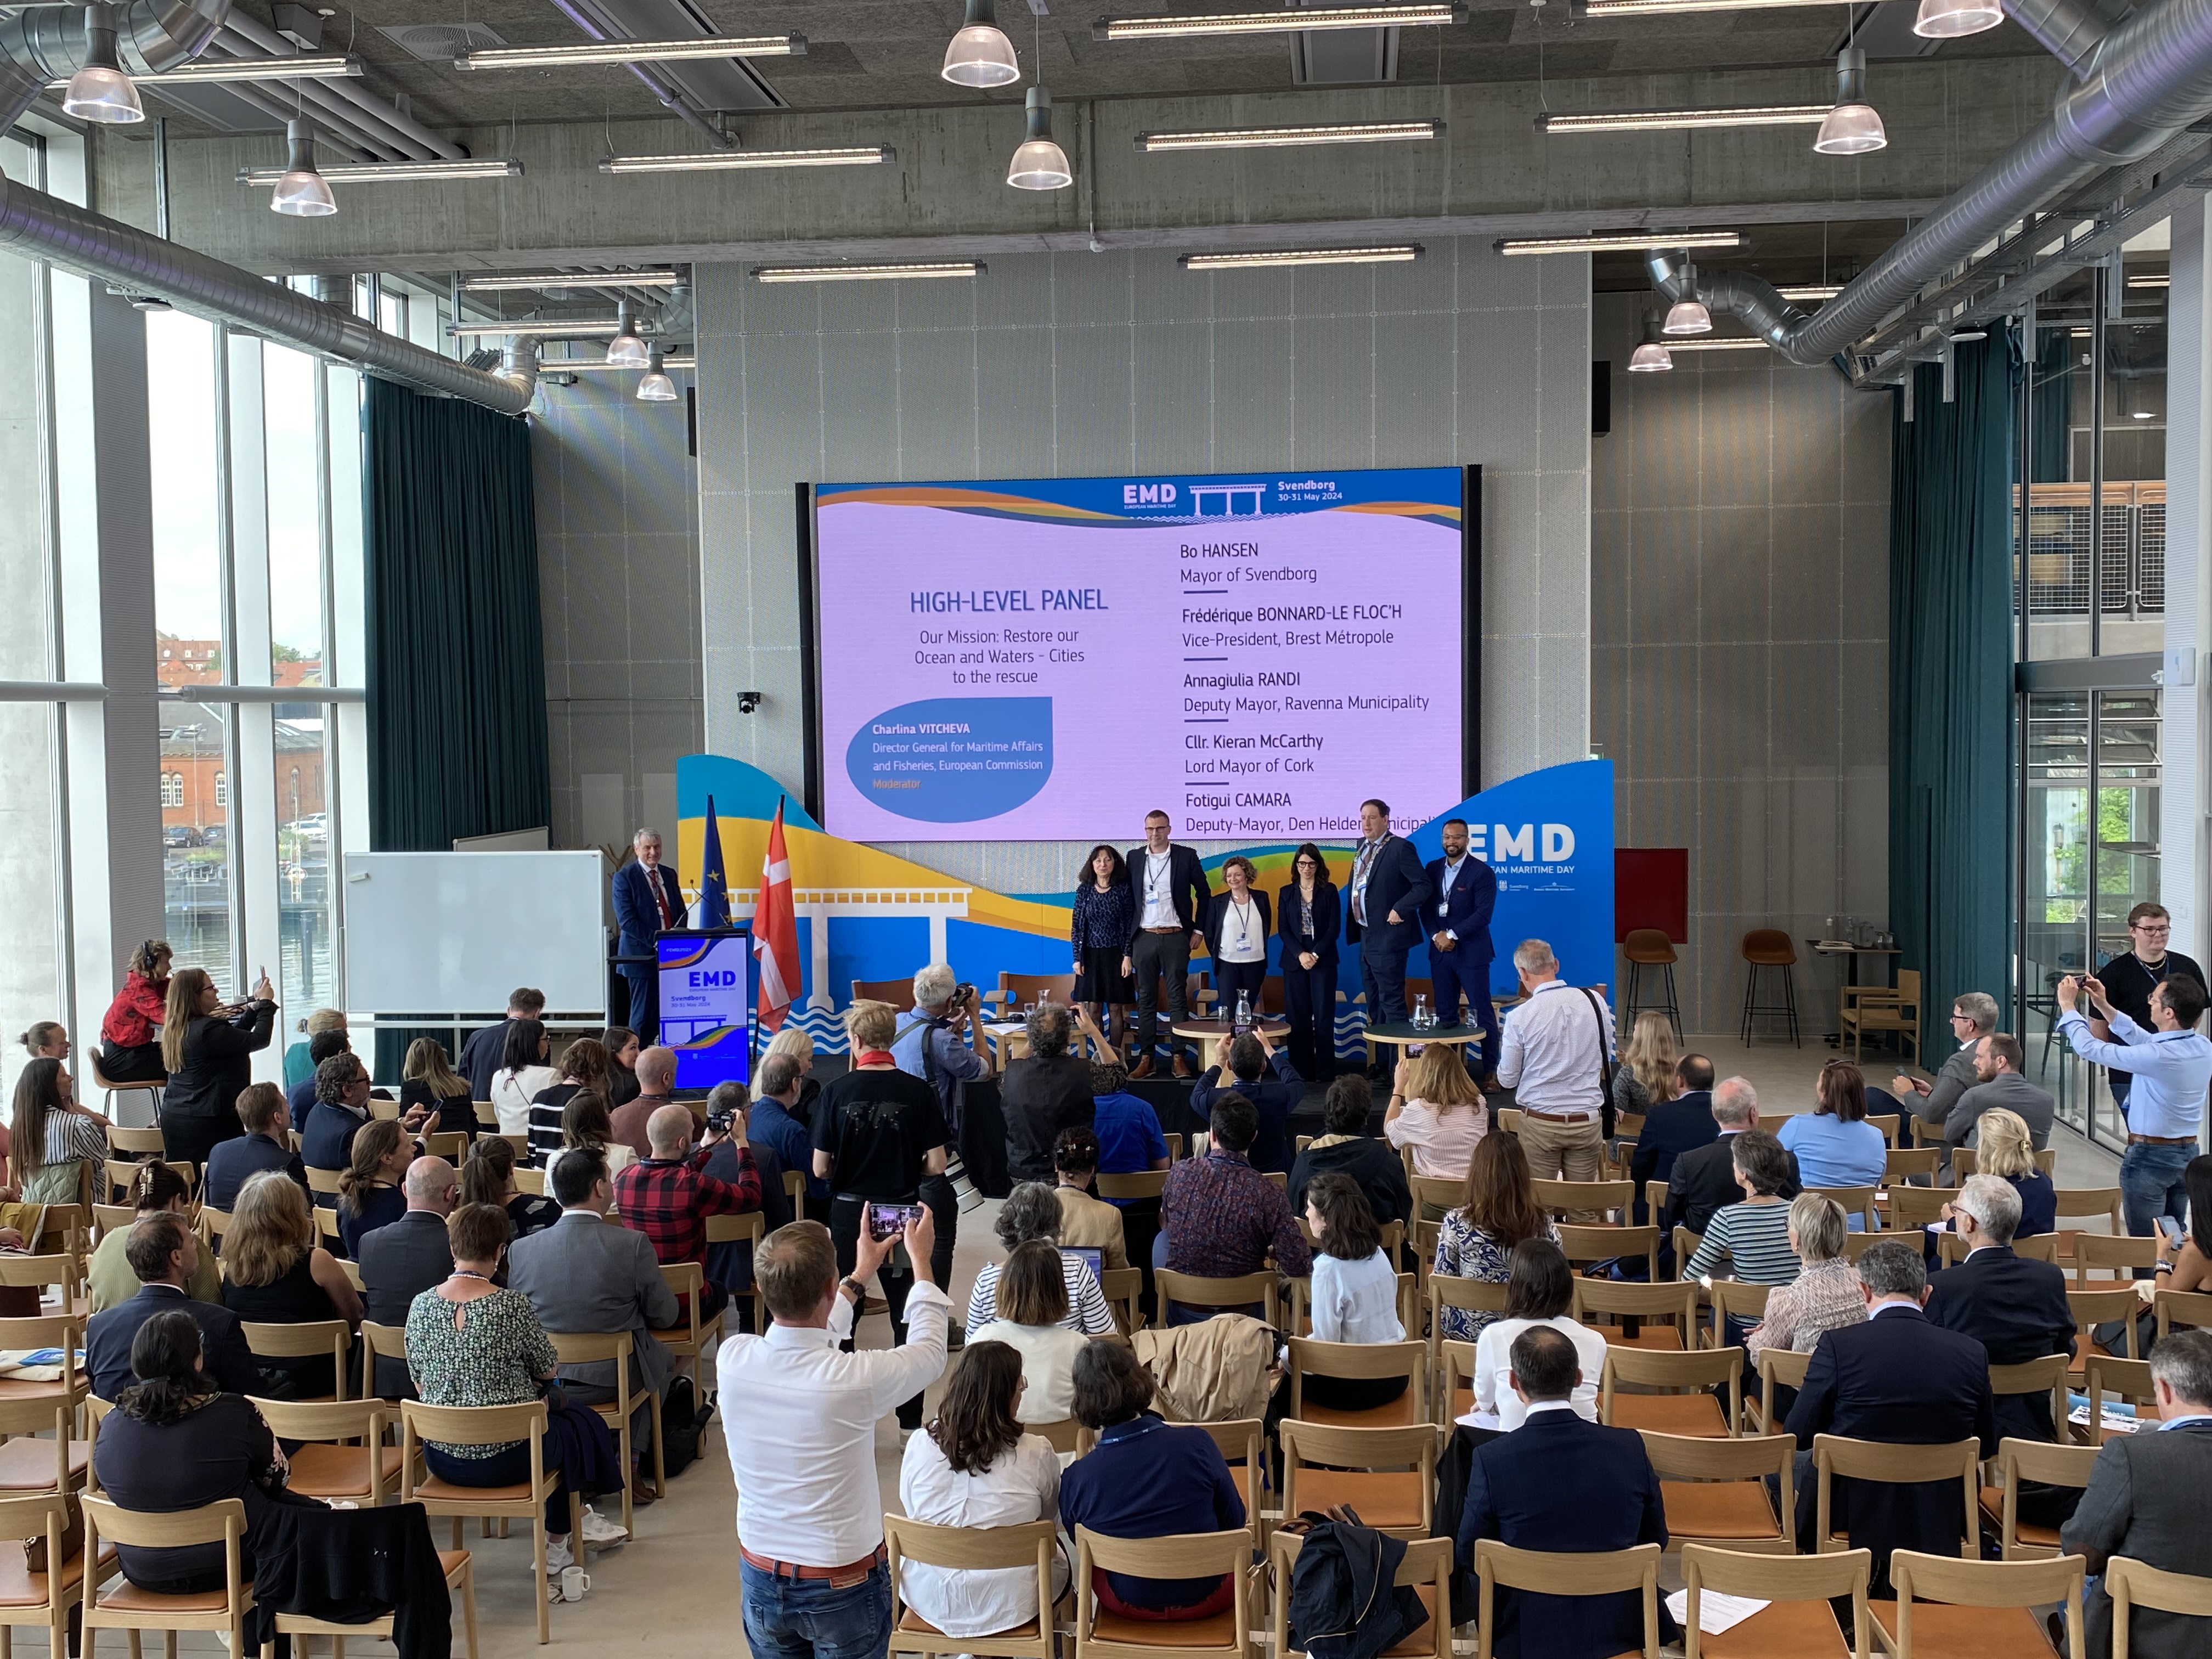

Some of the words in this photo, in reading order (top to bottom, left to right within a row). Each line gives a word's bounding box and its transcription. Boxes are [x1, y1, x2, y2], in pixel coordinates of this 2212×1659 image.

[1124, 484, 1176, 503] EMD
[1278, 481, 1335, 492] Svendborg
[1305, 493, 1319, 501] May
[1181, 545, 1198, 558] Bo
[1203, 543, 1258, 557] HANSEN
[1181, 569, 1223, 585] Mayor
[1227, 567, 1242, 581] of
[1245, 567, 1317, 583] Svendborg
[911, 590, 1035, 612] HIGH-LEVEL
[1042, 589, 1109, 610] PANEL
[1183, 608, 1253, 625] Frédérique
[1257, 606, 1348, 621] BONNARD-LE
[920, 631, 944, 644] Our
[947, 630, 999, 643] Mission:
[1004, 629, 1053, 642] Restore
[1057, 631, 1079, 641] our
[1182, 632, 1282, 647] Vice-President,
[1286, 631, 1321, 645] Brest
[1326, 629, 1393, 646] Métropole
[915, 651, 955, 664] Ocean
[960, 650, 984, 663] and
[988, 650, 1034, 663] Waters
[1049, 649, 1085, 662] Cities
[952, 672, 966, 683] to
[970, 670, 991, 683] the
[996, 673, 1038, 682] rescue
[1183, 673, 1254, 690] Annagiulia
[1259, 672, 1300, 686] RANDI
[1184, 698, 1231, 714] Deputy
[1236, 697, 1280, 714] Mayor,
[1285, 697, 1344, 710] Ravenna
[1348, 695, 1429, 712] Municipality
[872, 724, 916, 735] Charlina
[919, 724, 970, 733] VITCHEVA
[872, 743, 910, 753] Director
[912, 742, 947, 752] General
[951, 742, 964, 752] for
[967, 742, 1008, 752] Maritime
[1011, 741, 1043, 751] Affairs
[1184, 735, 1210, 749] Cllr.
[1214, 735, 1255, 748] Kieran
[1260, 733, 1323, 751] McCarthy
[873, 761, 890, 771] and
[894, 760, 936, 772] Fisheries,
[939, 760, 983, 772] European
[985, 760, 1043, 770] Commission
[1186, 759, 1214, 772] Lord
[1220, 759, 1262, 775] Mayor
[1266, 758, 1280, 772] of
[1284, 758, 1314, 771] Cork
[873, 778, 921, 789] Moderator
[1186, 794, 1230, 810] Fotigui
[1235, 793, 1292, 806] CAMARA
[1186, 818, 1285, 834] Deputy-Mayor,
[1289, 817, 1314, 830] Den
[1467, 823, 1575, 862] EMD
[689, 971, 736, 987] EMD
